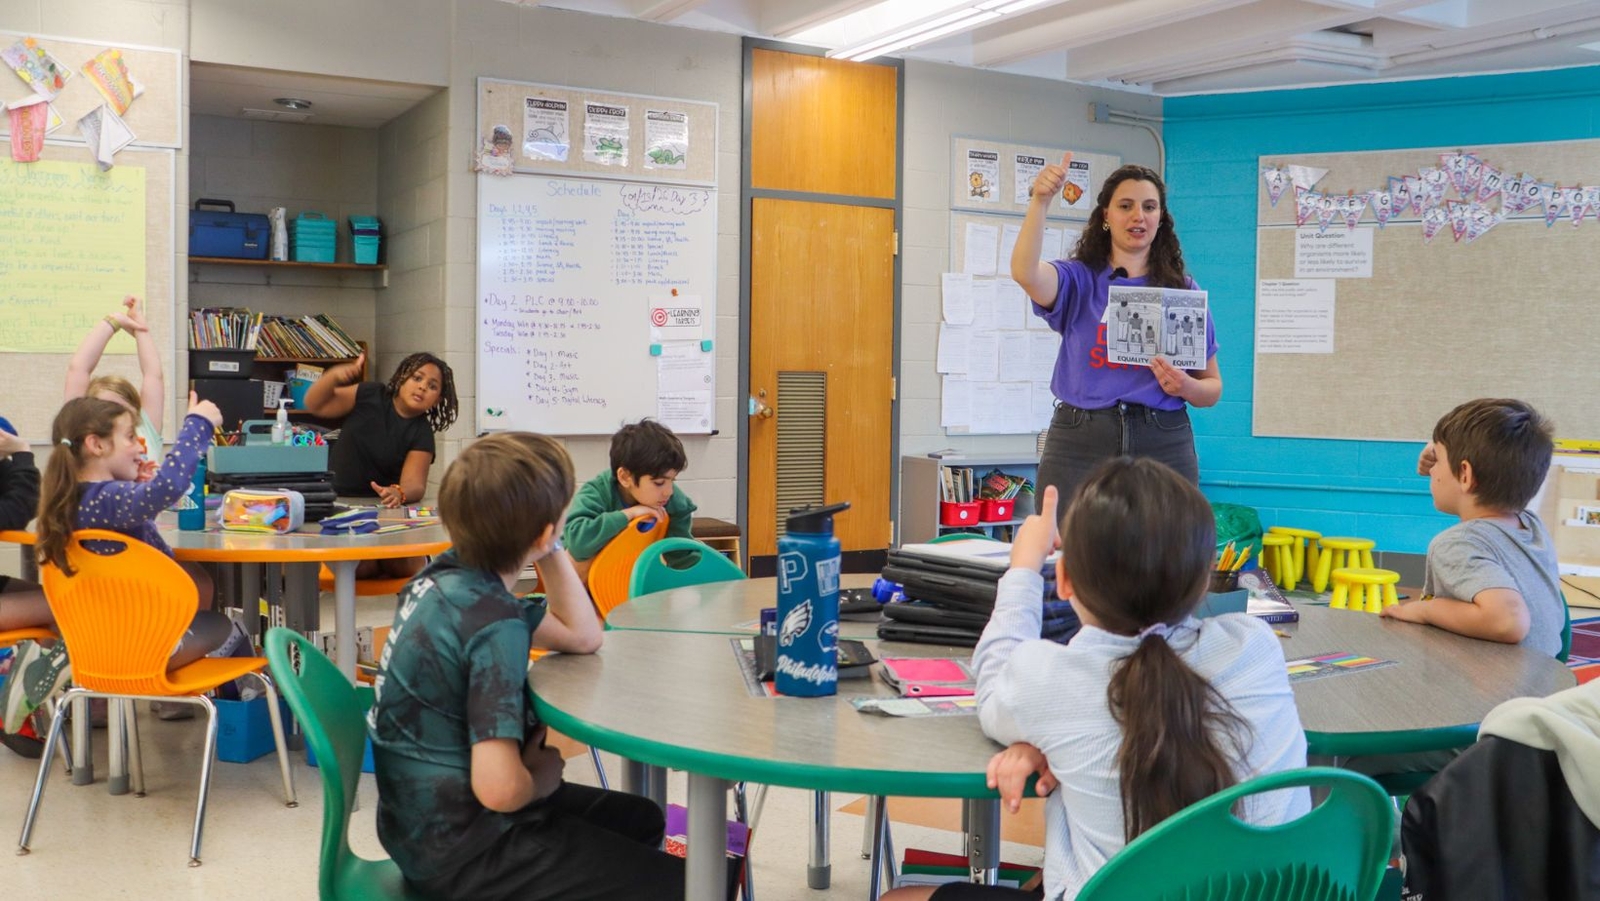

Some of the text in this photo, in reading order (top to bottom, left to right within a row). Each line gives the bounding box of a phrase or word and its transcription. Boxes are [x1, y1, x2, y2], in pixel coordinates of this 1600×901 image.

[1273, 173, 1282, 183] A
[1305, 195, 1314, 205] C
[1324, 200, 1331, 209] D
[1381, 195, 1389, 205] G
[1399, 185, 1408, 196] H
[1434, 172, 1441, 183] J
[1454, 158, 1462, 169] K
[546, 180, 602, 197] Schedule
[670, 190, 687, 206] Day
[688, 191, 699, 206] 3
[617, 208, 629, 221] Day
[1459, 206, 1469, 217] Y
[489, 293, 509, 312] Day
[510, 294, 517, 306] 2
[525, 295, 545, 306] PLC
[670, 309, 700, 318] LEARNING
[491, 318, 515, 332] Monday
[675, 317, 696, 325] TARGETS
[492, 328, 515, 341] Tuesday
[533, 348, 548, 361] Day
[557, 350, 579, 360] Music
[1117, 355, 1150, 364] EQUALITY
[533, 360, 548, 374] Day
[533, 372, 547, 384] Day
[559, 372, 580, 381] Music
[534, 383, 550, 396] Day
[534, 395, 550, 408] Day
[779, 551, 809, 595] P
